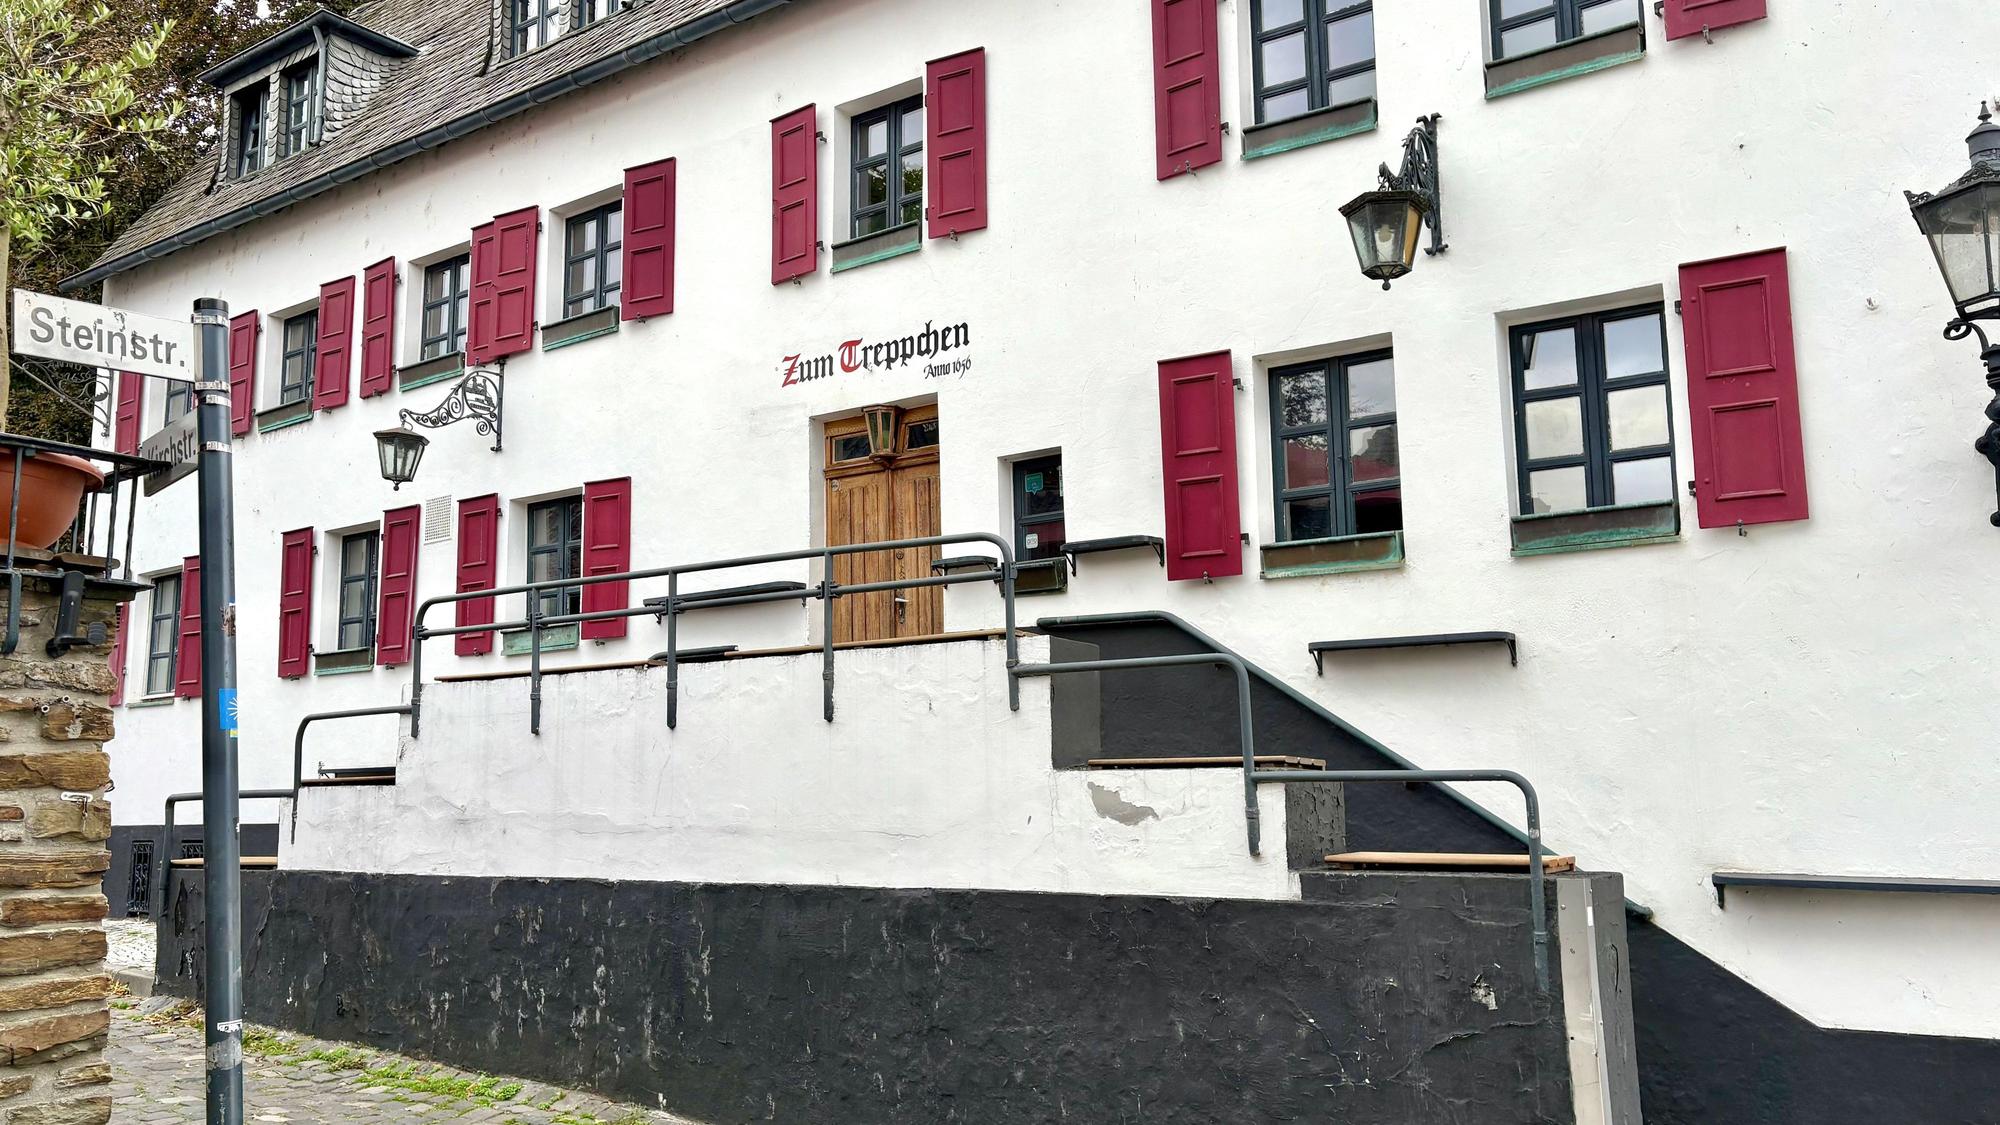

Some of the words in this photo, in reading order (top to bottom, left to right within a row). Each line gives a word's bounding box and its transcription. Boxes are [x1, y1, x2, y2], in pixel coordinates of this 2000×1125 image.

[29, 306, 186, 367] Steinstr.
[781, 353, 834, 388] Zum
[837, 319, 970, 374] Treppchen
[923, 361, 951, 379] Anno
[952, 354, 972, 379] 1656
